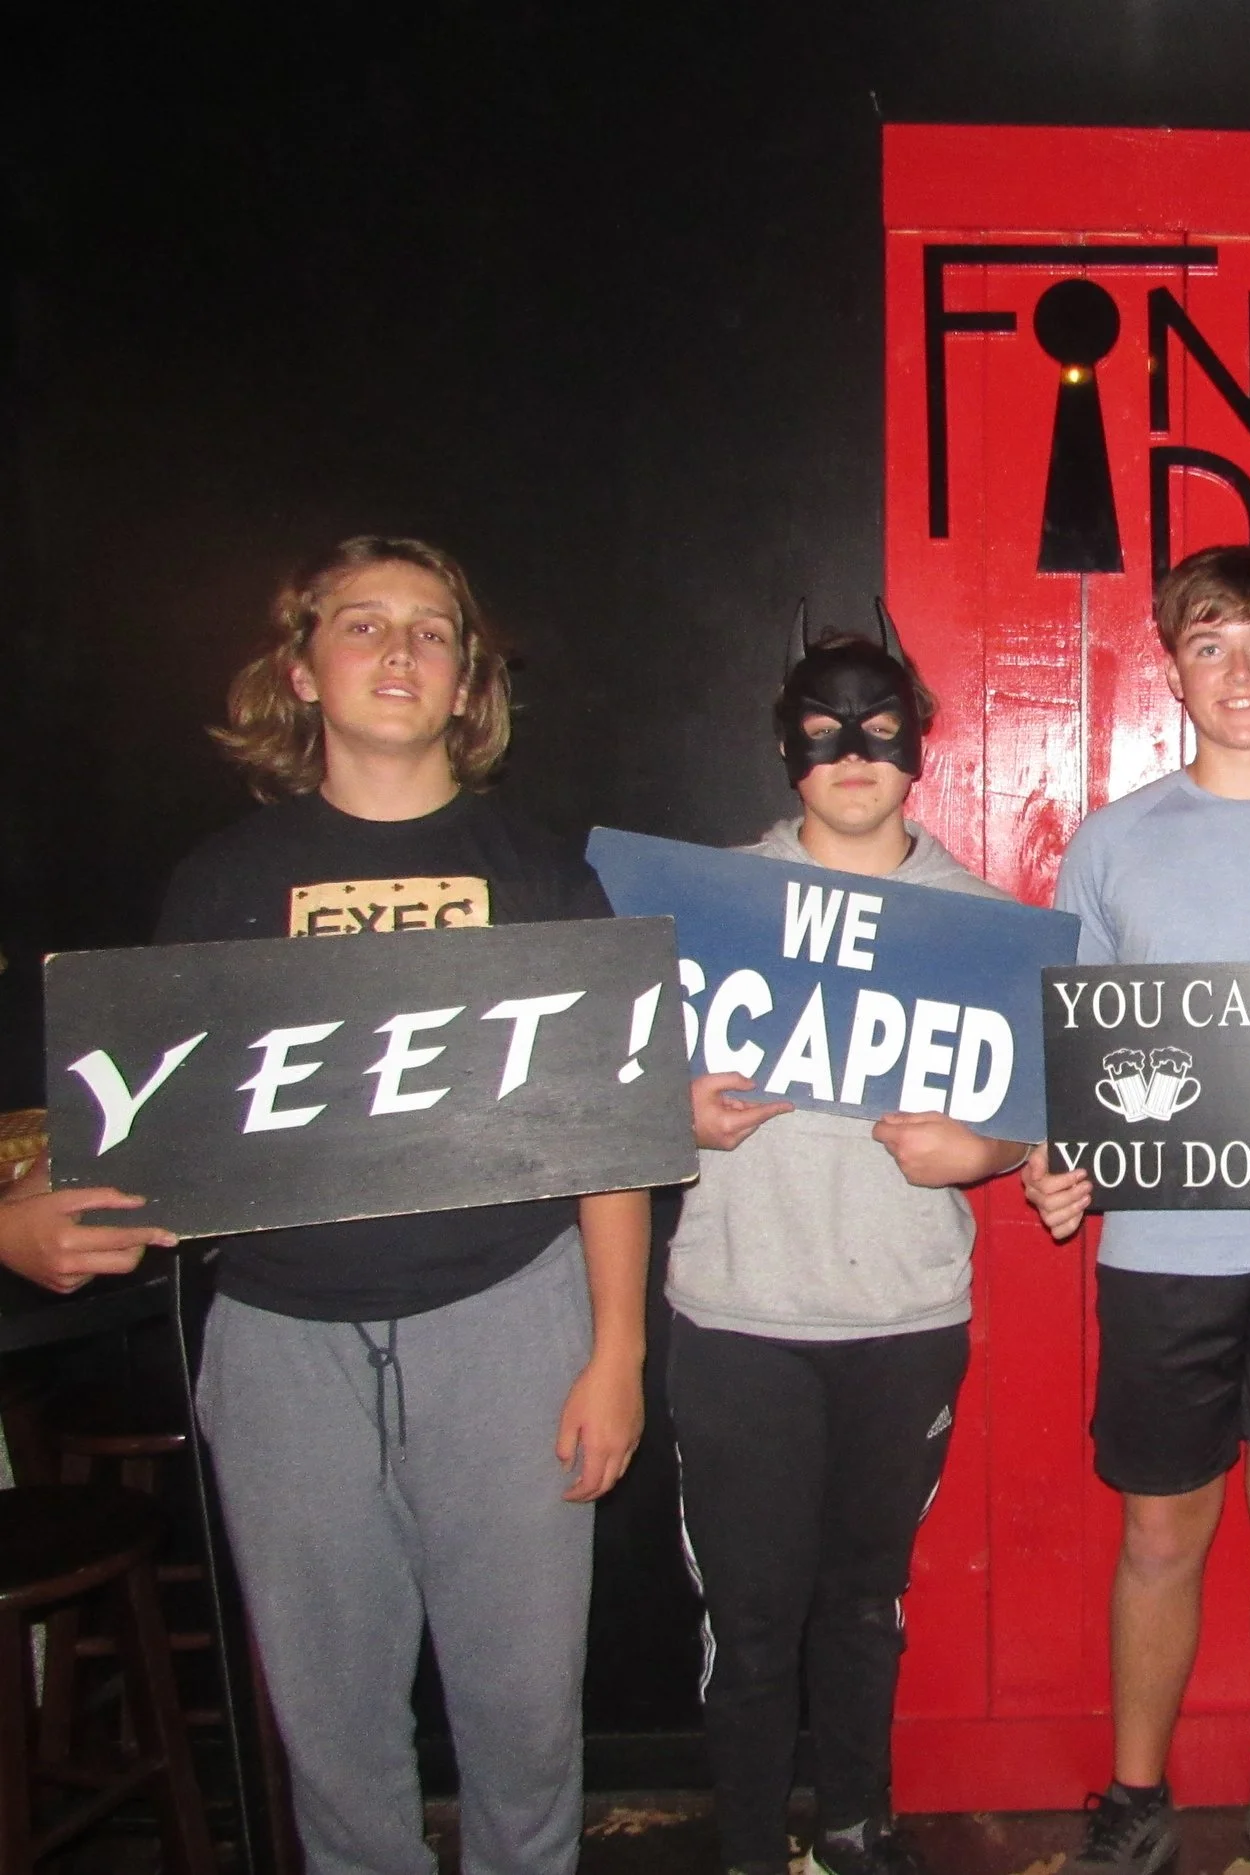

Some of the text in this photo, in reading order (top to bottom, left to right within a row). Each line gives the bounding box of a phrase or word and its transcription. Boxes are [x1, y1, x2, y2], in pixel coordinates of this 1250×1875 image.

[782, 881, 884, 972] WE
[1053, 981, 1165, 1028] YOU
[1054, 1140, 1166, 1189] YOU
